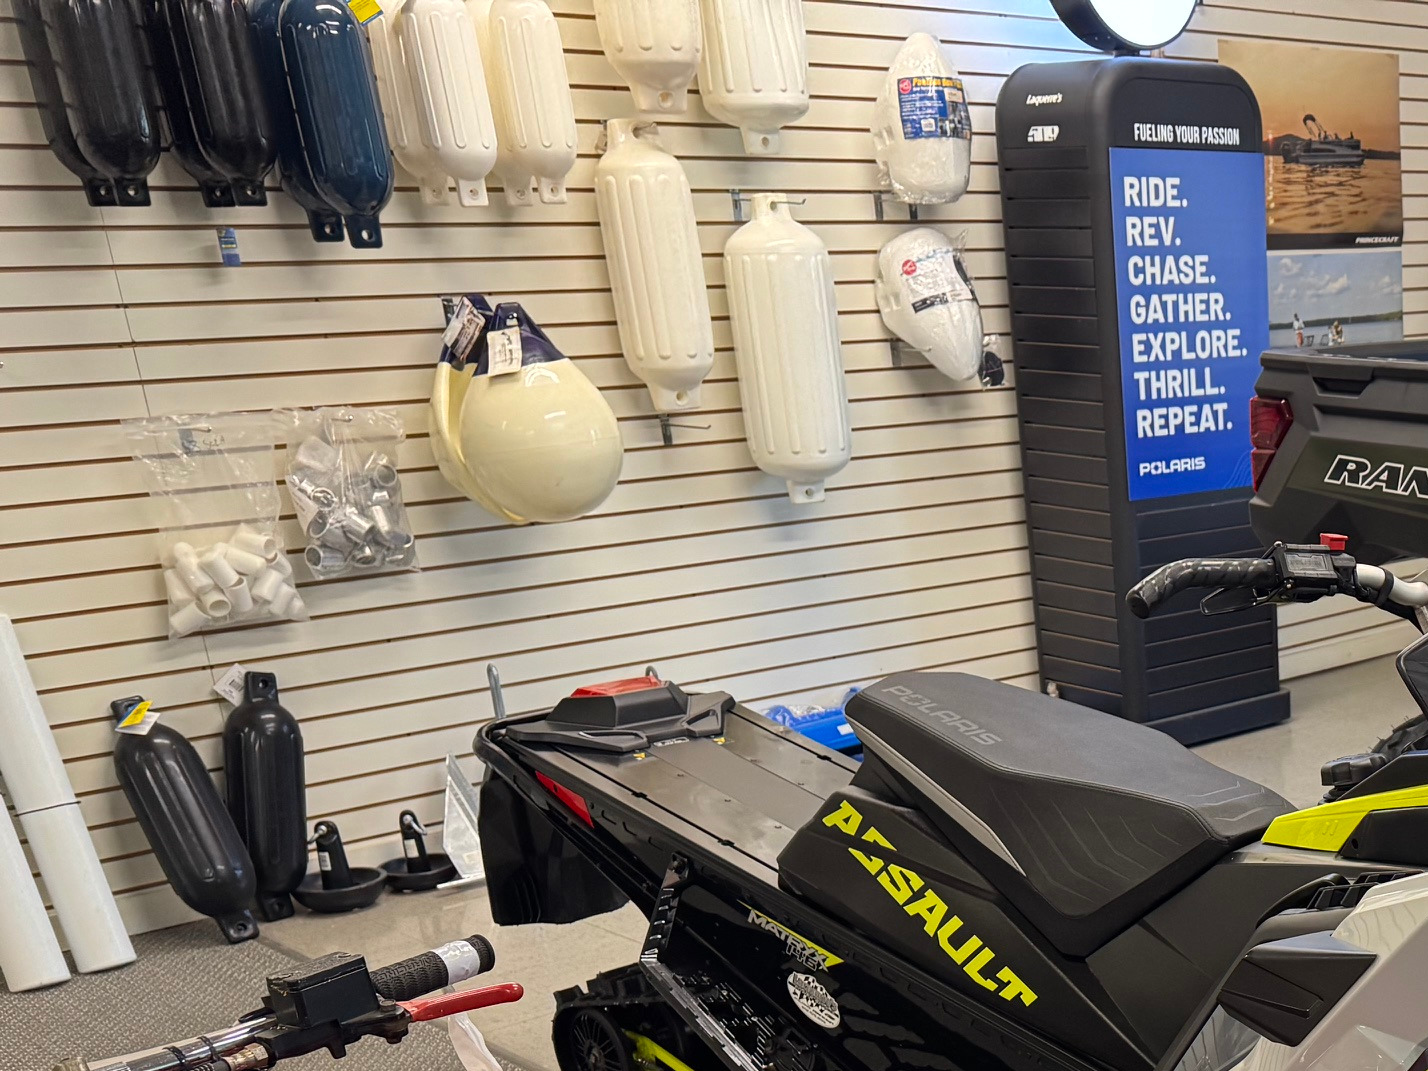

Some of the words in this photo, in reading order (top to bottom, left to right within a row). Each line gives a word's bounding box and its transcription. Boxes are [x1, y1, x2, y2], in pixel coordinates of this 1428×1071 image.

[1134, 123, 1173, 143] FUELING
[1175, 125, 1200, 144] YOUR
[1202, 127, 1240, 146] PASSION
[1123, 176, 1188, 208] RIDE.
[1125, 216, 1181, 247] REV.
[1127, 254, 1216, 286] CHASE.
[1130, 292, 1232, 325] GATHER.
[1132, 329, 1248, 363] EXPLORE.
[1133, 366, 1226, 401] THRILL.
[1136, 402, 1233, 439] REPEAT.
[1139, 456, 1206, 477] POLARIS
[882, 685, 1002, 745] POLARIS
[822, 799, 1038, 1007] ASSAULT
